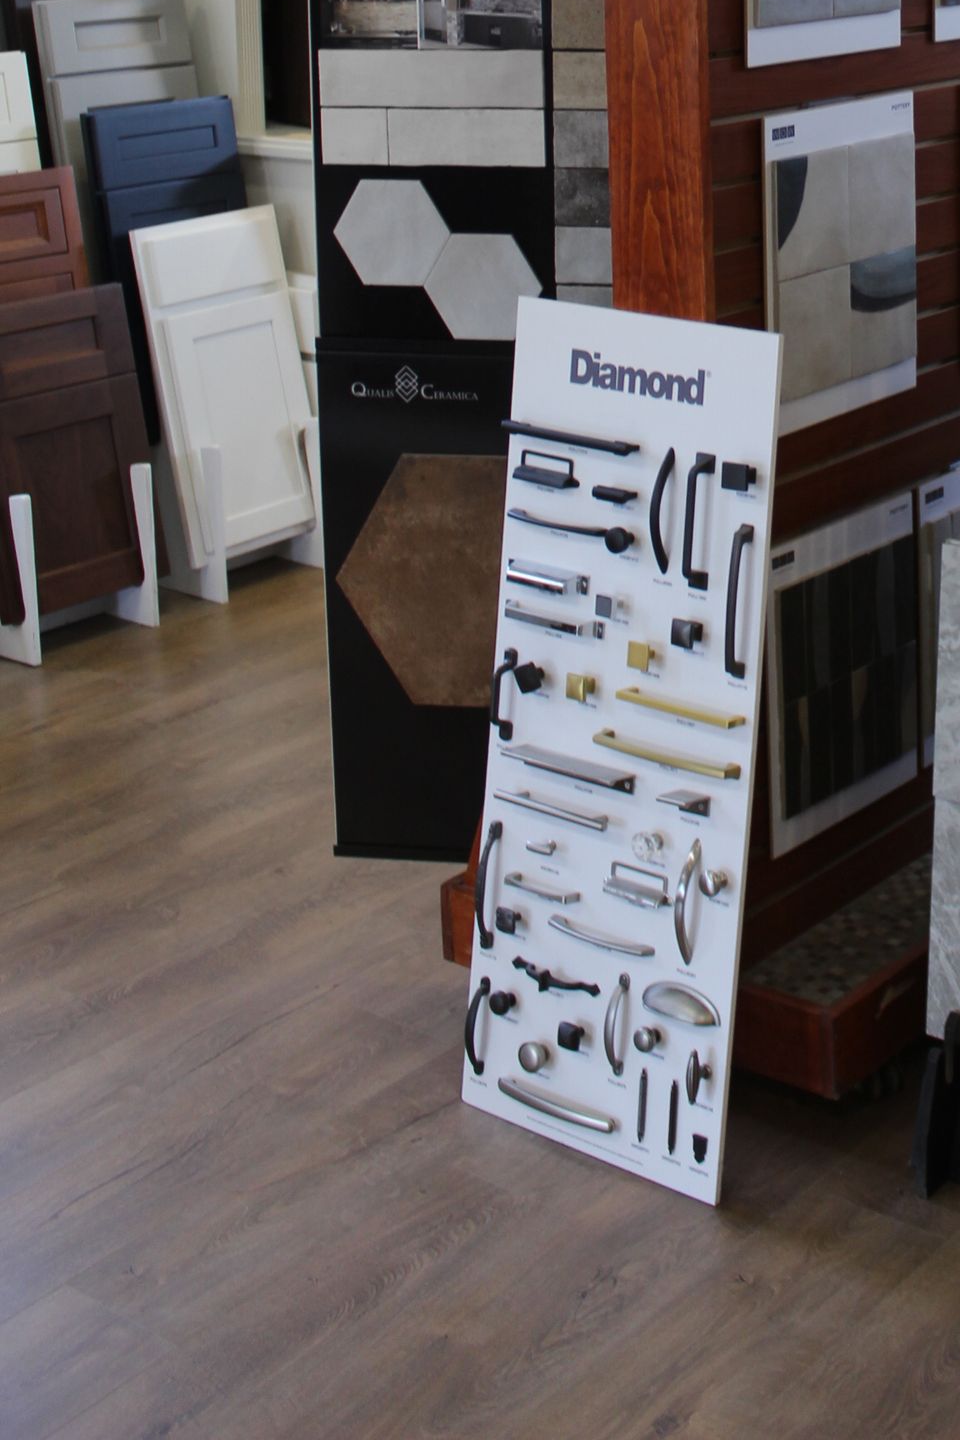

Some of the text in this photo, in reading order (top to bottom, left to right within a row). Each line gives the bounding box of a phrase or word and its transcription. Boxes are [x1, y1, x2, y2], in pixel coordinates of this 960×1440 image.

[351, 381, 479, 401] QUALIS CERAMICA
[569, 347, 706, 407] Diamond
